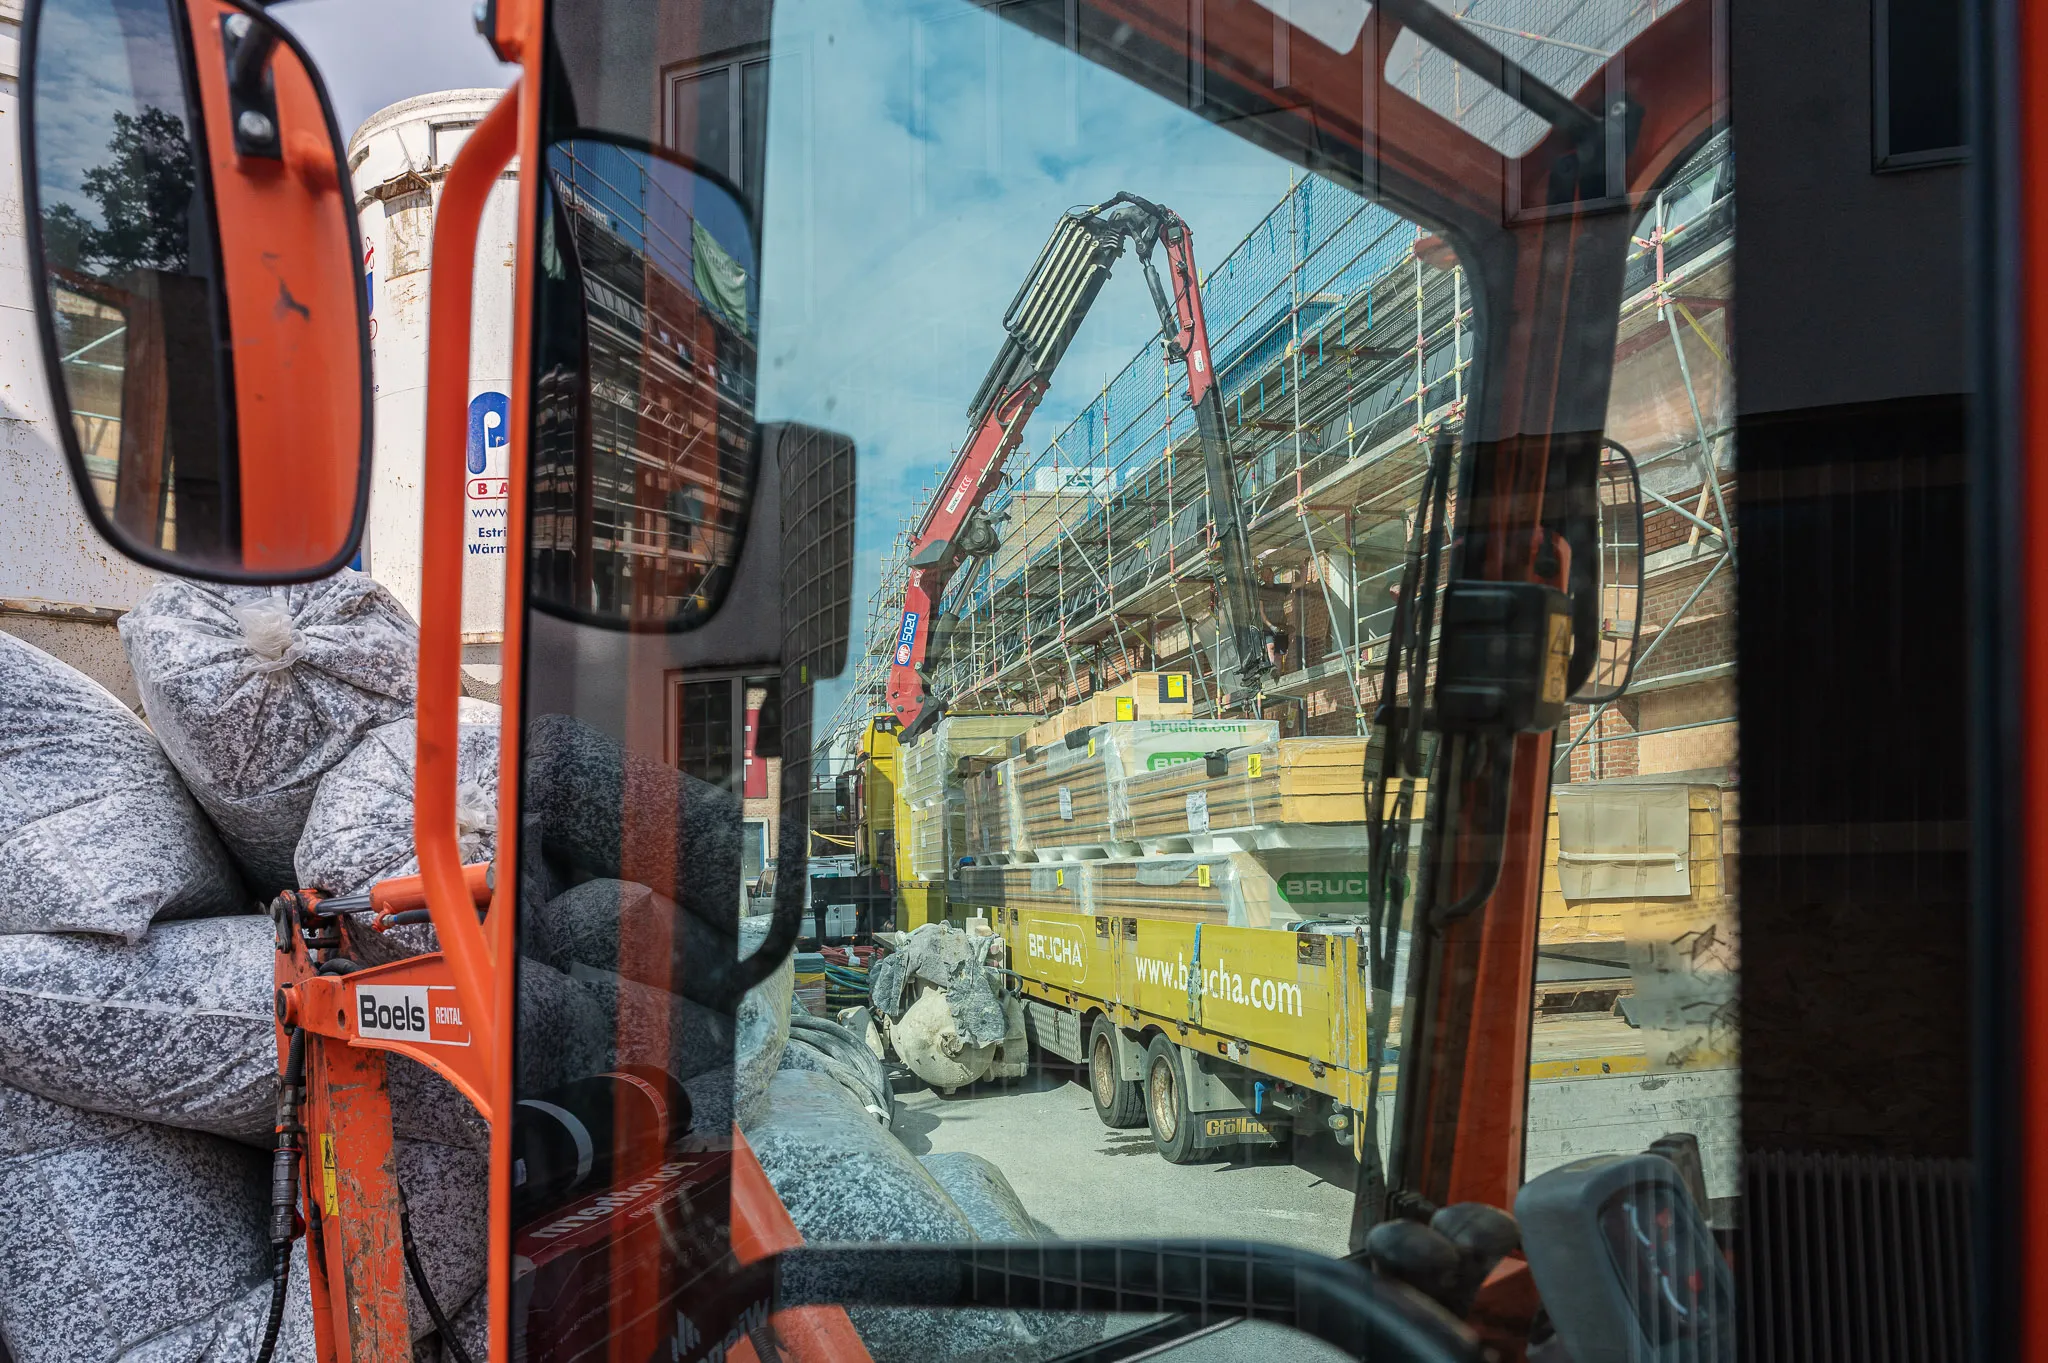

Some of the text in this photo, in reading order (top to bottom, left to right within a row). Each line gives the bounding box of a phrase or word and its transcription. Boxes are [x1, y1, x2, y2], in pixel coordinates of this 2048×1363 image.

[903, 613, 916, 641] 5020
[1150, 719, 1247, 733] brucha.com
[1286, 879, 1369, 896] BRUC
[1028, 933, 1083, 968] BRUCHA
[1135, 951, 1303, 1017] www.bucha.com
[359, 994, 463, 1032] Boels RENTAL
